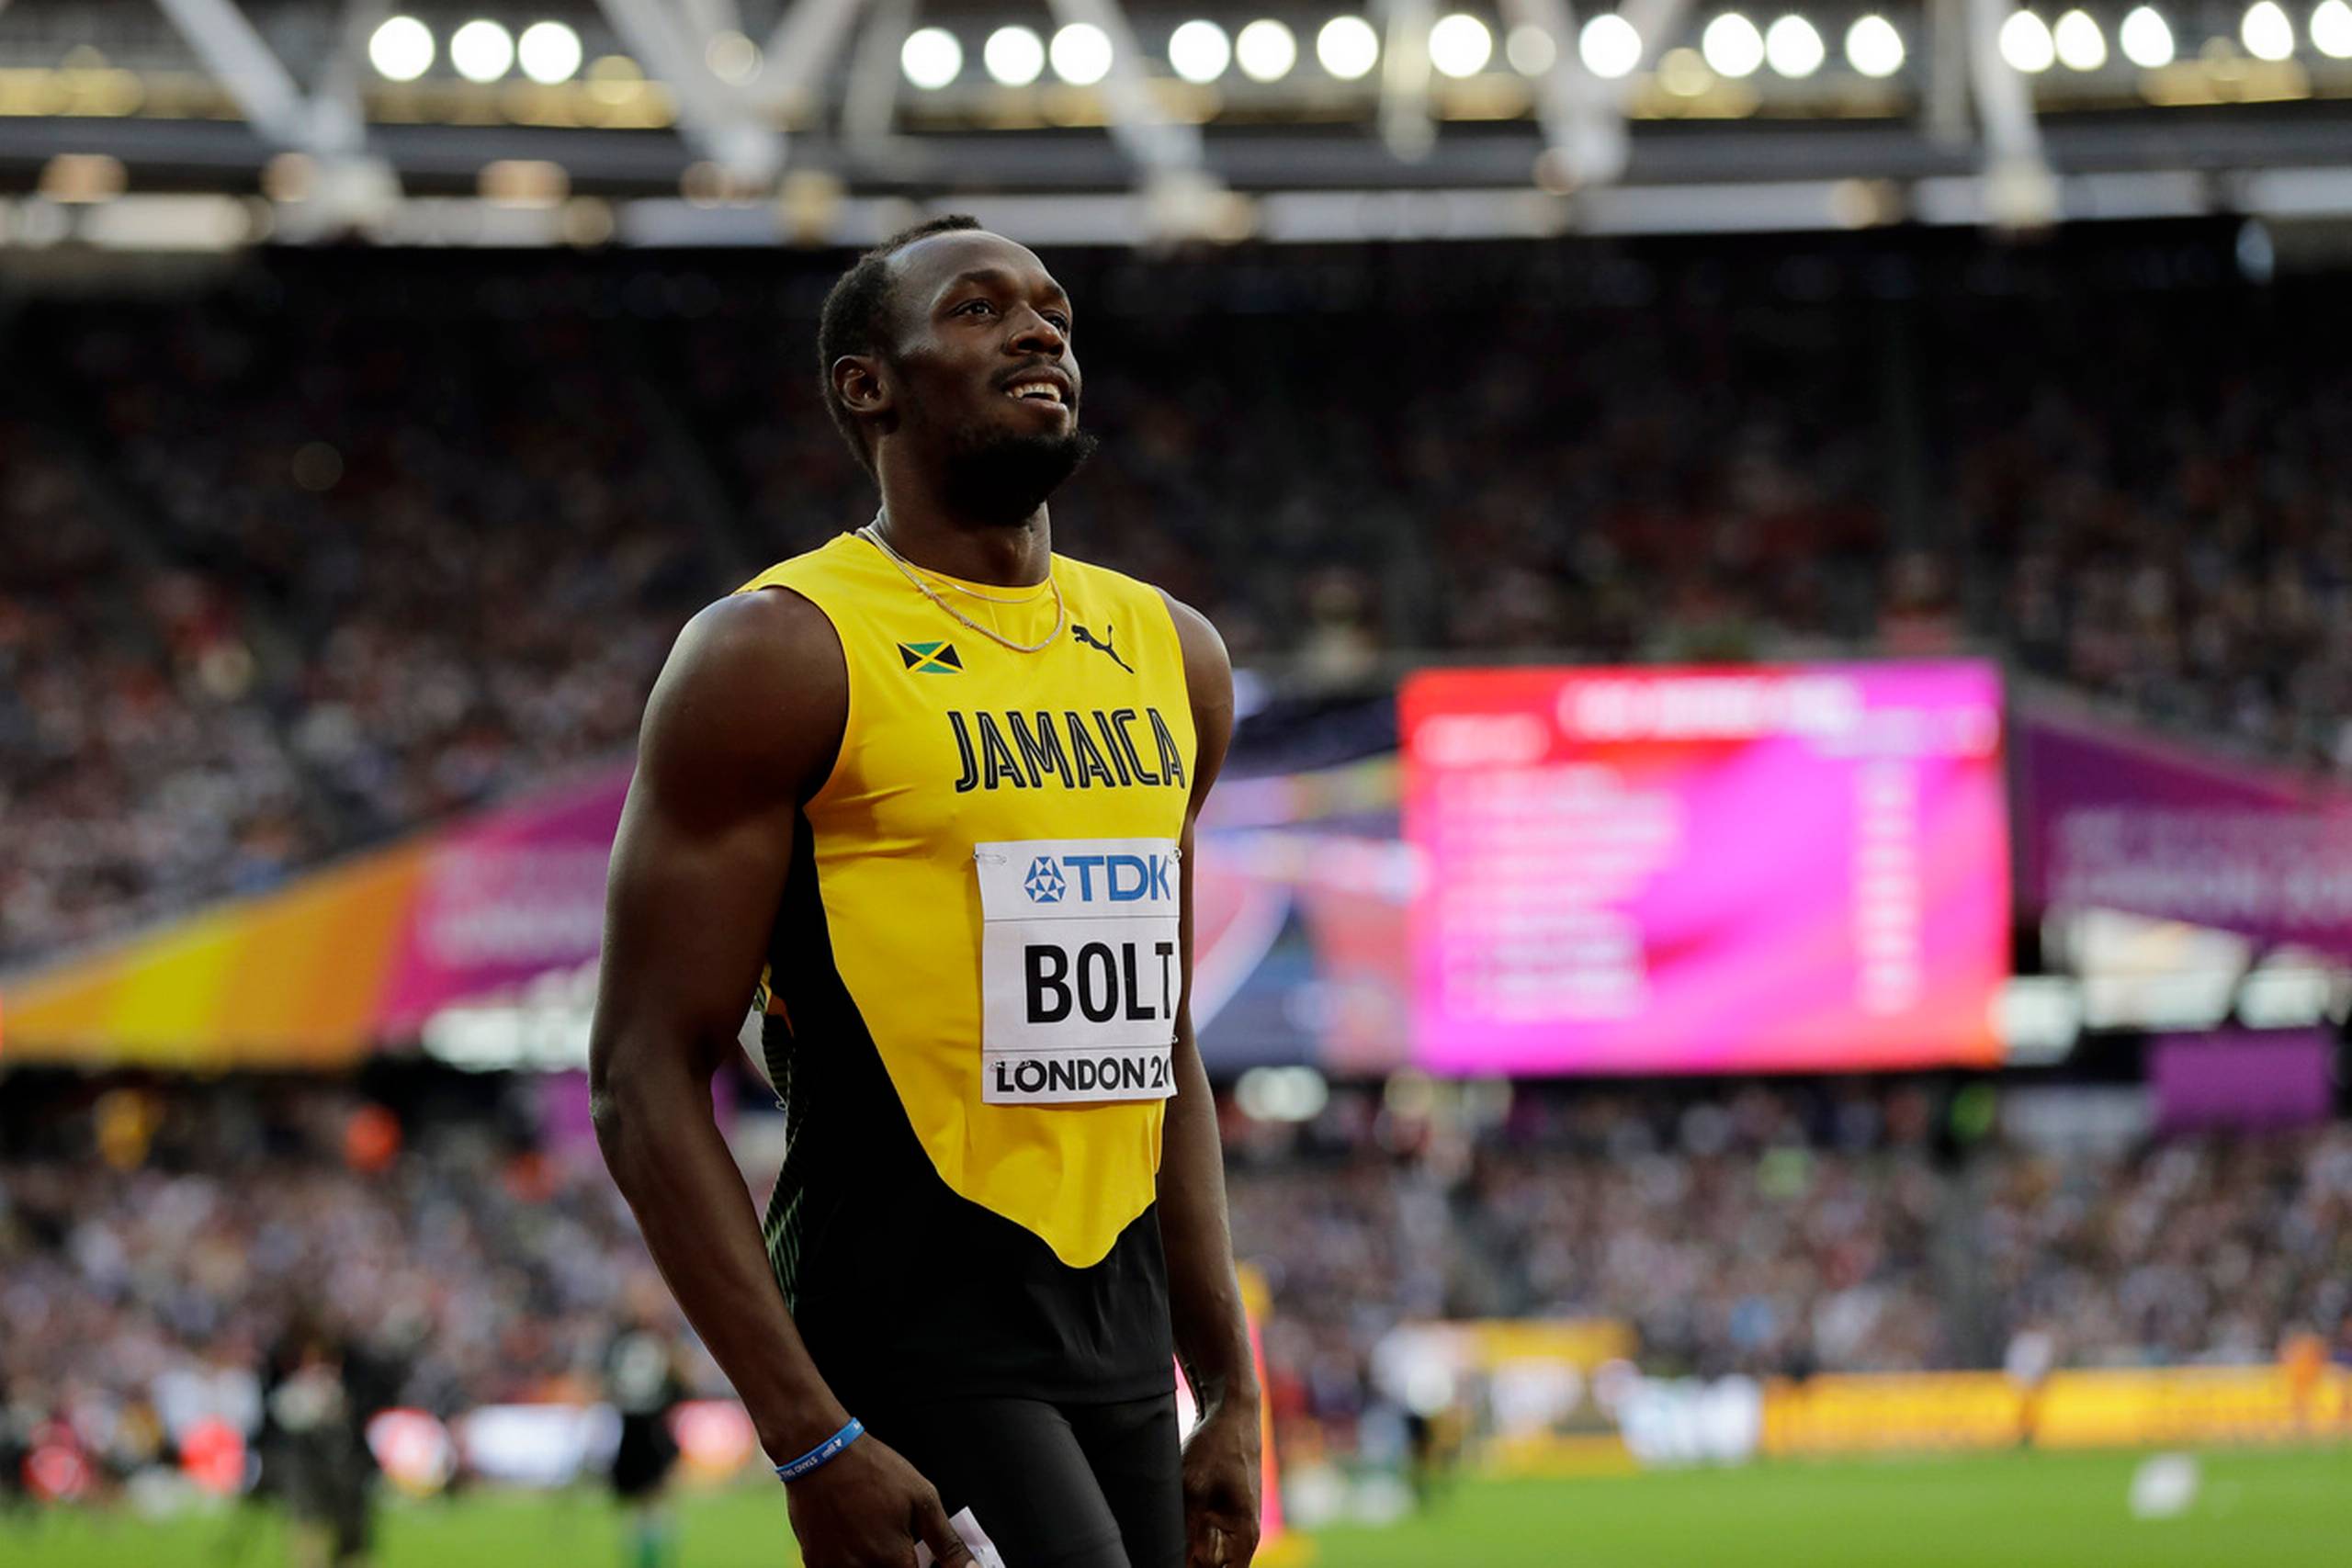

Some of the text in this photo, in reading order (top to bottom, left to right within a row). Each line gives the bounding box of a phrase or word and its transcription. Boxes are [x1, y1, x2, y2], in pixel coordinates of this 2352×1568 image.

[946, 706, 1185, 793] JAMAICA
[1062, 854, 1171, 902] TDK
[1024, 942, 1173, 1024] BOLT
[996, 1057, 1145, 1093] LONDON
